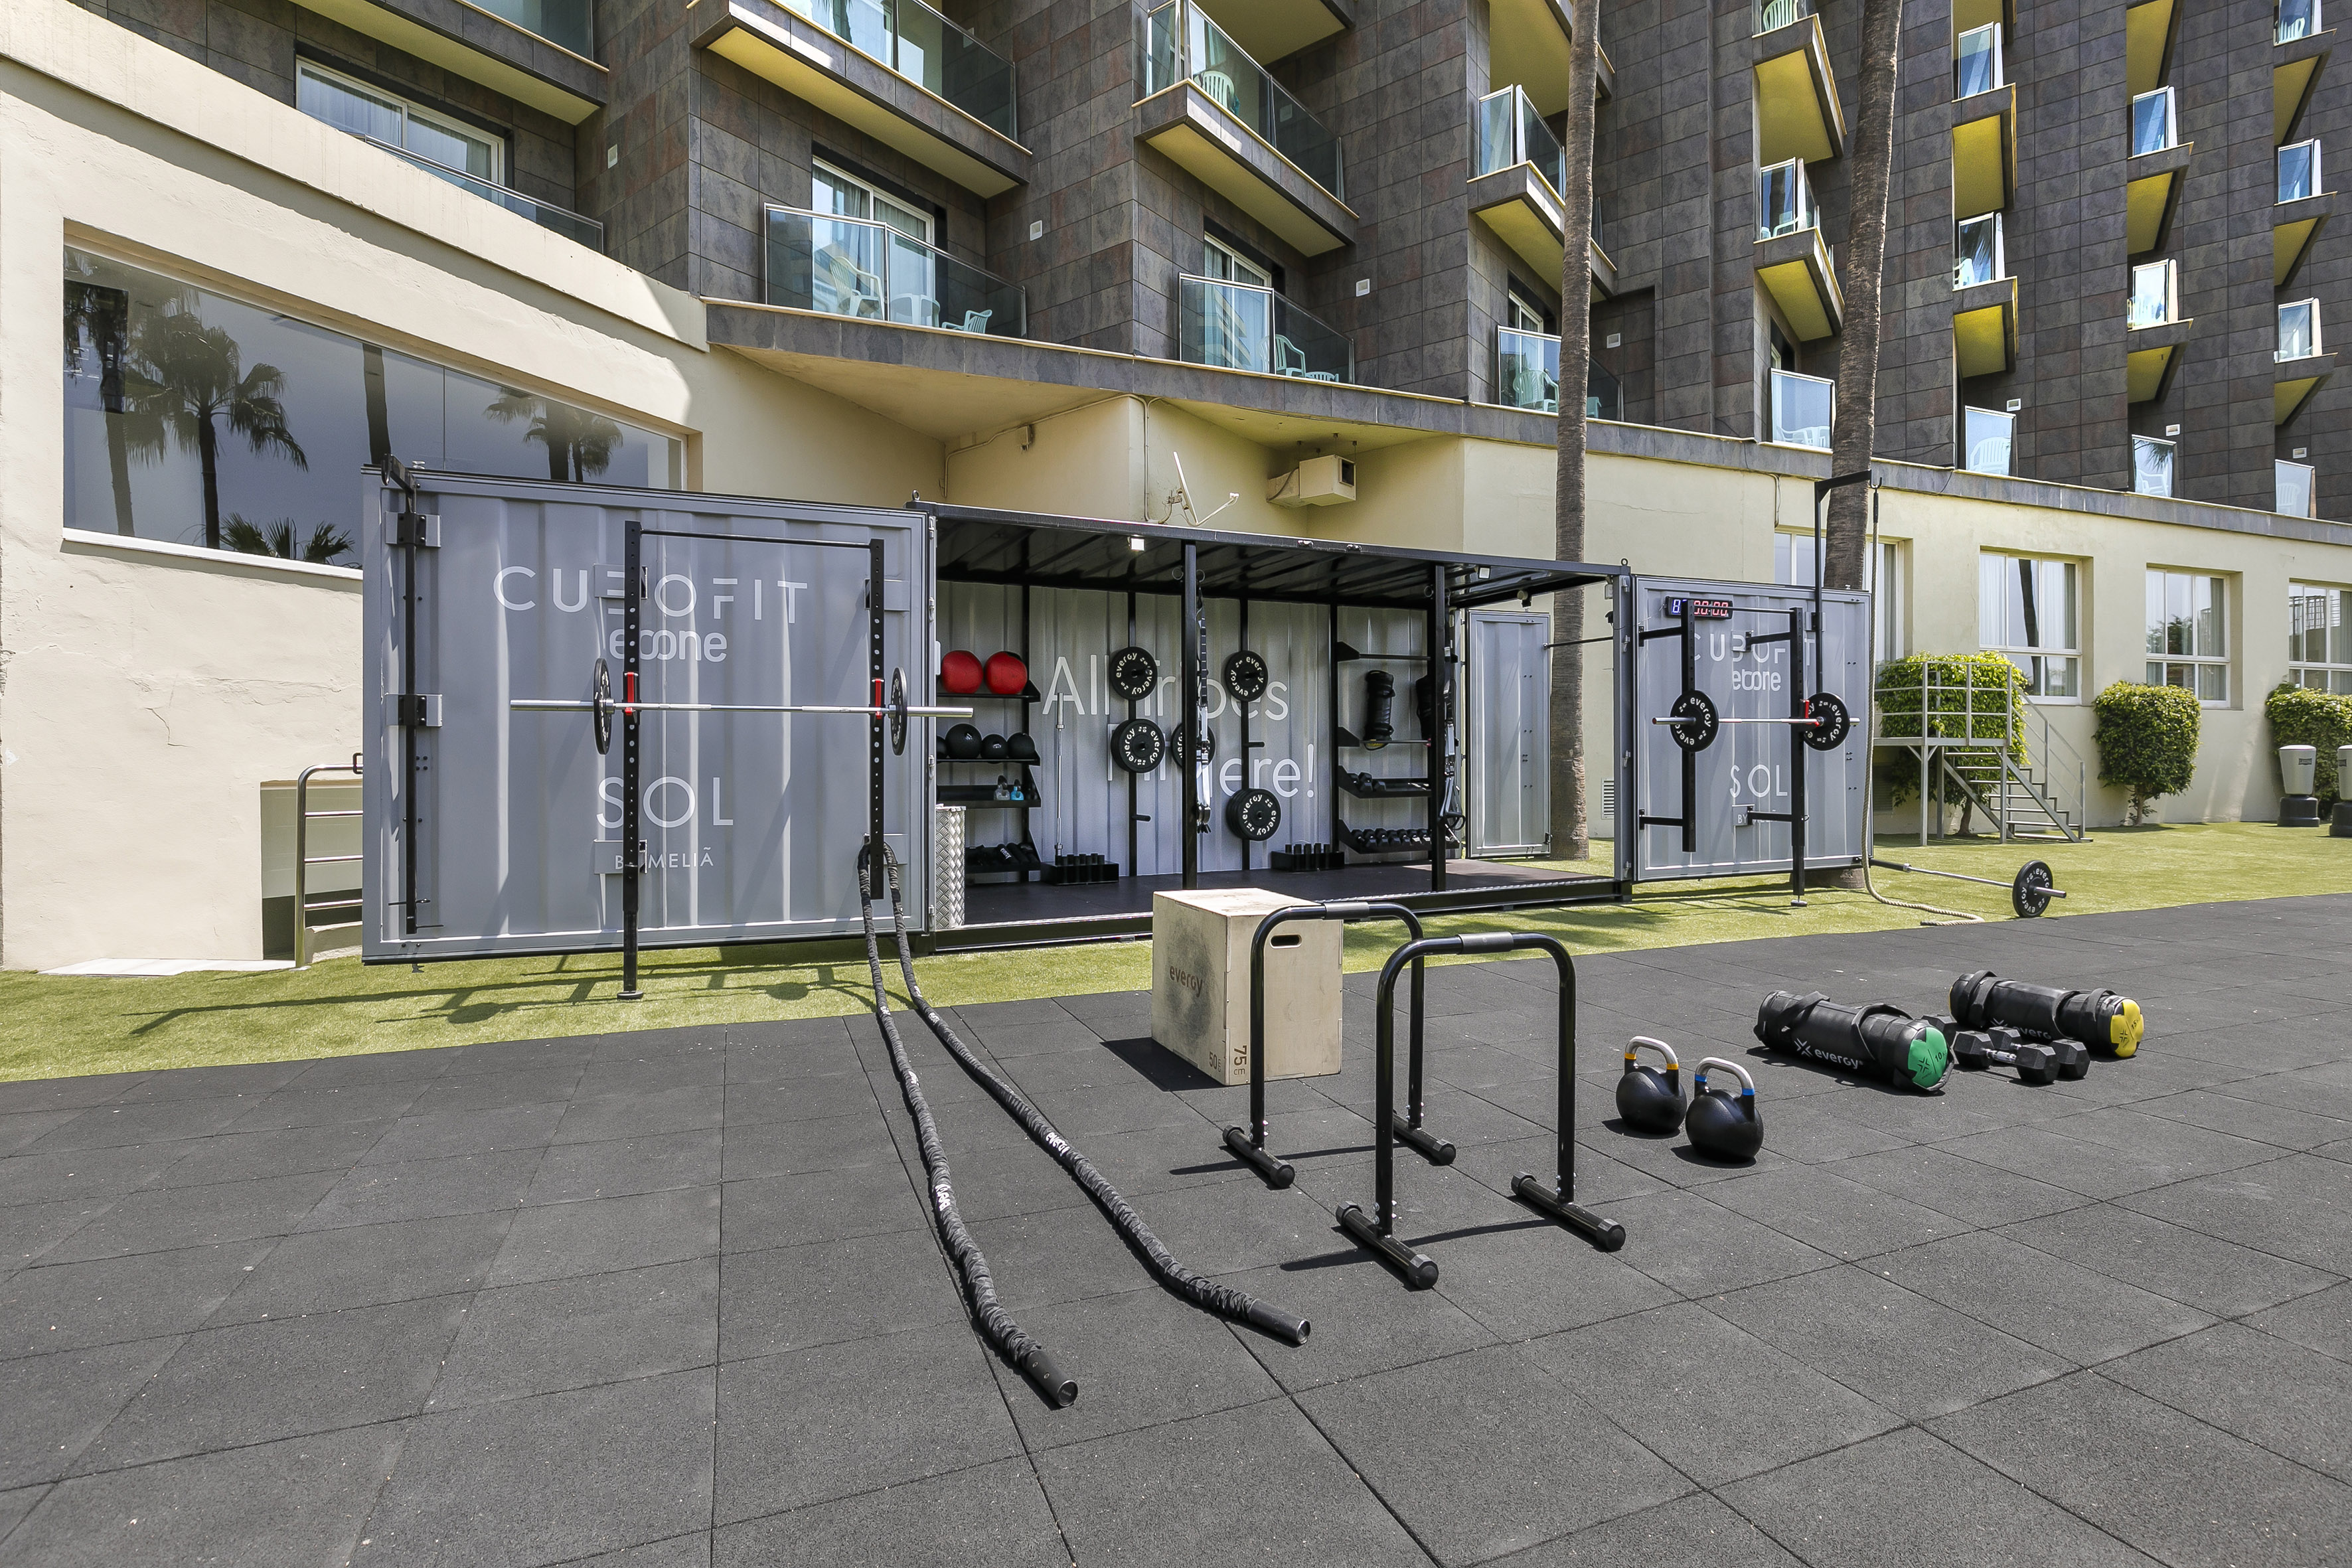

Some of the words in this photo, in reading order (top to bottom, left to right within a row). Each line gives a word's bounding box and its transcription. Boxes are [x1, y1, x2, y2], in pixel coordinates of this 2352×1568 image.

[1116, 653, 1137, 678] evergy
[1246, 657, 1264, 683] every
[1042, 654, 1110, 716] All
[1230, 670, 1248, 696] evergy
[1690, 697, 1711, 727] evergy
[1830, 704, 1842, 742] evergy
[1674, 716, 1695, 745] everg
[1124, 728, 1135, 762] evergy
[1149, 730, 1160, 763] evergy
[1208, 743, 1315, 798] ere!
[1729, 764, 1788, 798] SOL
[596, 776, 734, 828] SOL
[1242, 794, 1263, 820] evergy
[1257, 810, 1277, 836] evergy
[1737, 814, 1748, 824] BY
[2035, 868, 2050, 888] everg
[2021, 886, 2036, 913] evergy
[1169, 965, 1203, 998] evergy
[1209, 1051, 1217, 1070] 50
[1233, 1045, 1247, 1066] 75
[1814, 1048, 1859, 1070] evergy
[1934, 1052, 1942, 1062] 10
